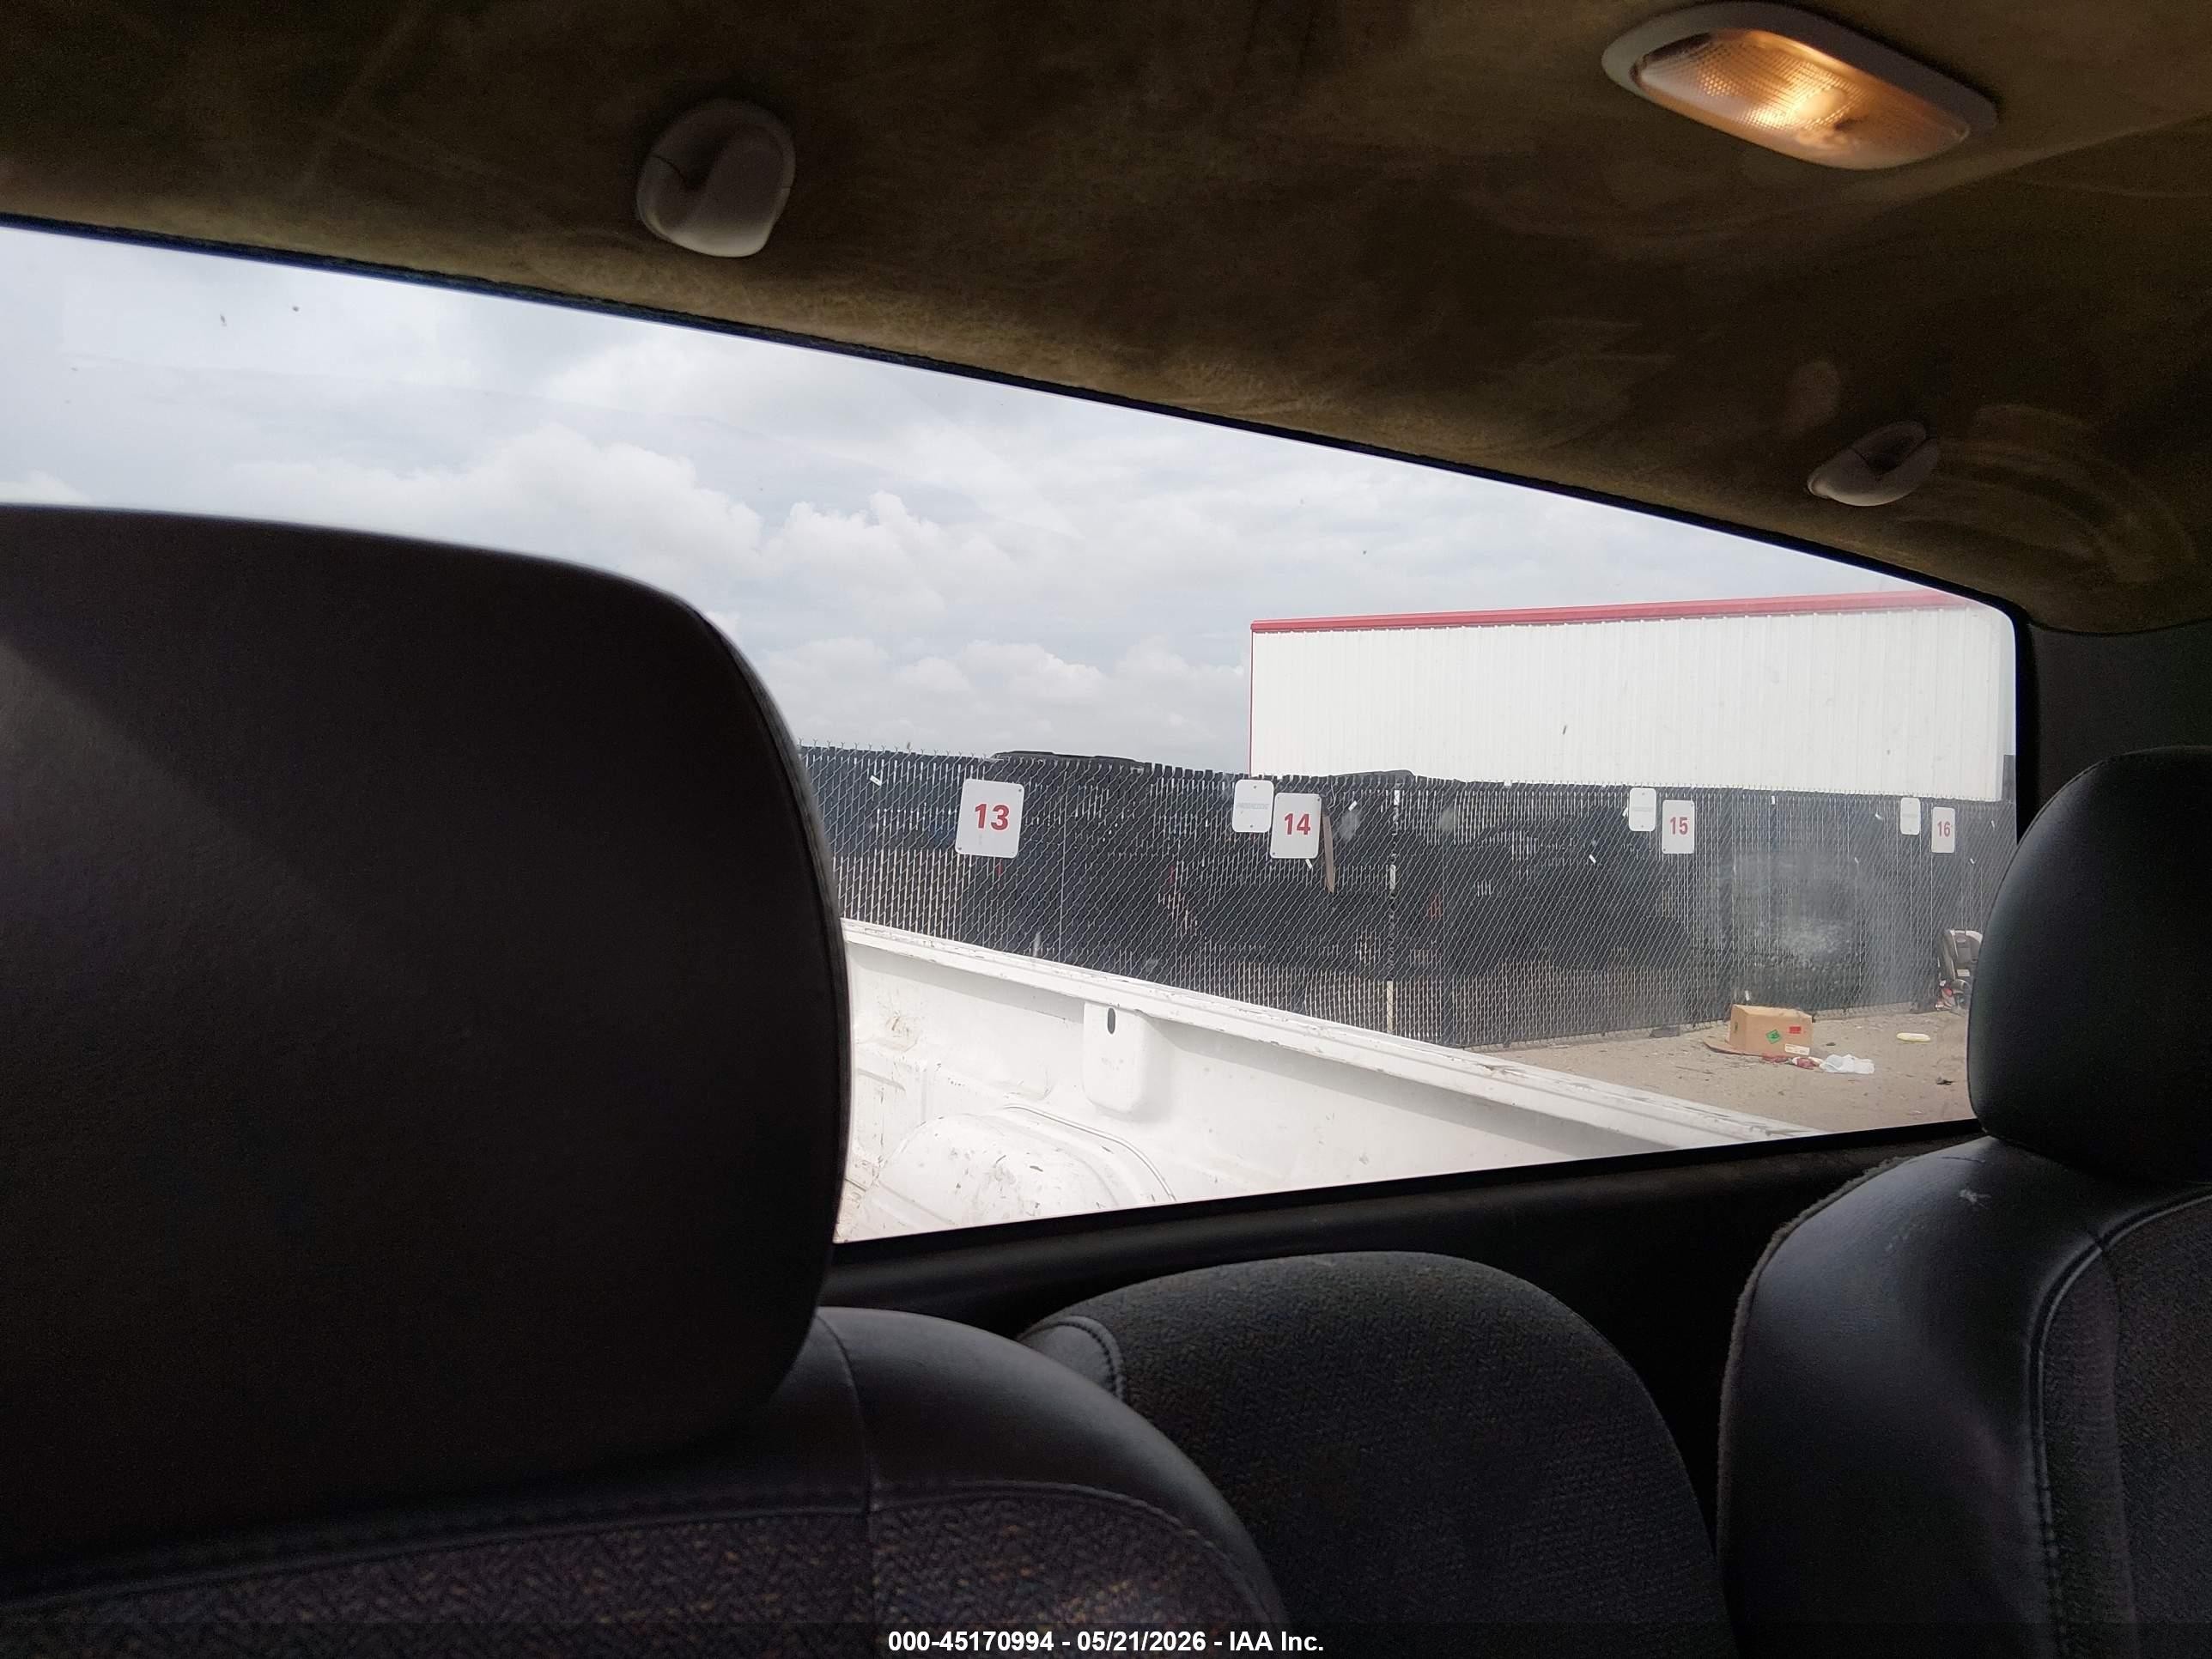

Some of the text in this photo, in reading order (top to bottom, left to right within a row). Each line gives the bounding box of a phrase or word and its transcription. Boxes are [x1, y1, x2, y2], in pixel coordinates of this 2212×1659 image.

[975, 803, 1010, 831] 13
[1284, 812, 1312, 836] 14
[1670, 817, 1688, 835] 15
[1937, 821, 1951, 837] 16
